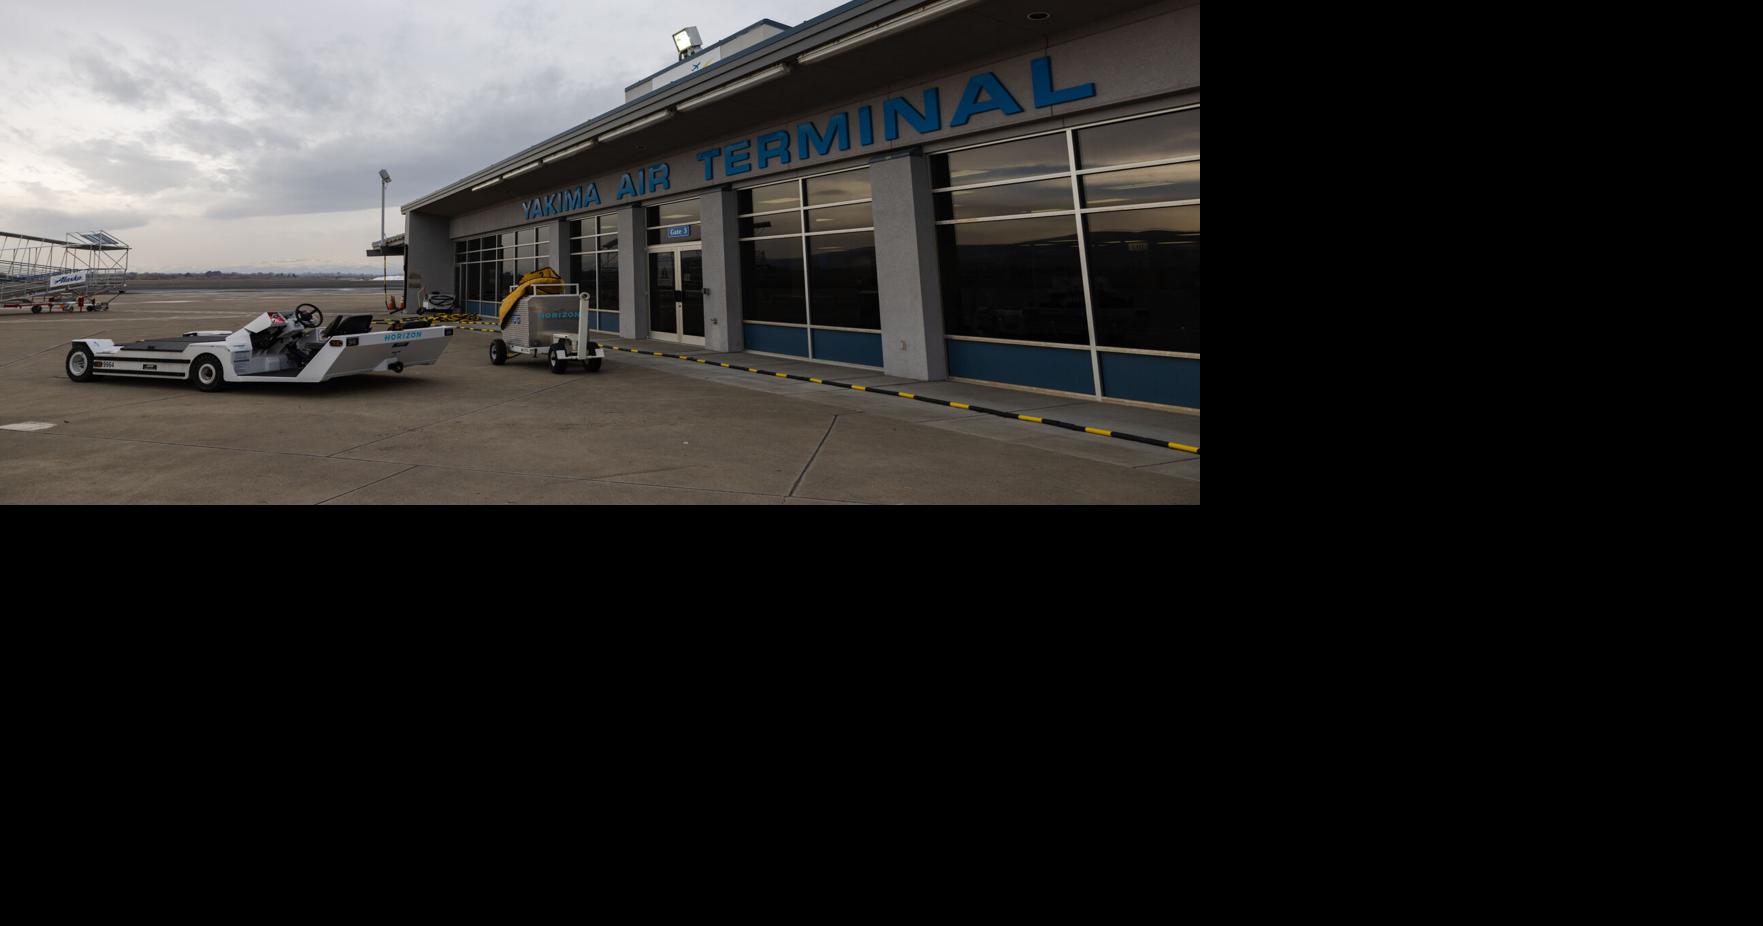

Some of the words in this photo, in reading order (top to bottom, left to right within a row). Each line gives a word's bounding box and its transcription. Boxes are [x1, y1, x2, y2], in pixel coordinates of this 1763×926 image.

[522, 182, 601, 220] YAKIMA
[616, 162, 671, 200] AIR
[696, 55, 1096, 181] TERMINAL
[670, 228, 682, 236] Gate
[538, 311, 580, 319] HORIZON
[384, 331, 422, 341] HORIZON
